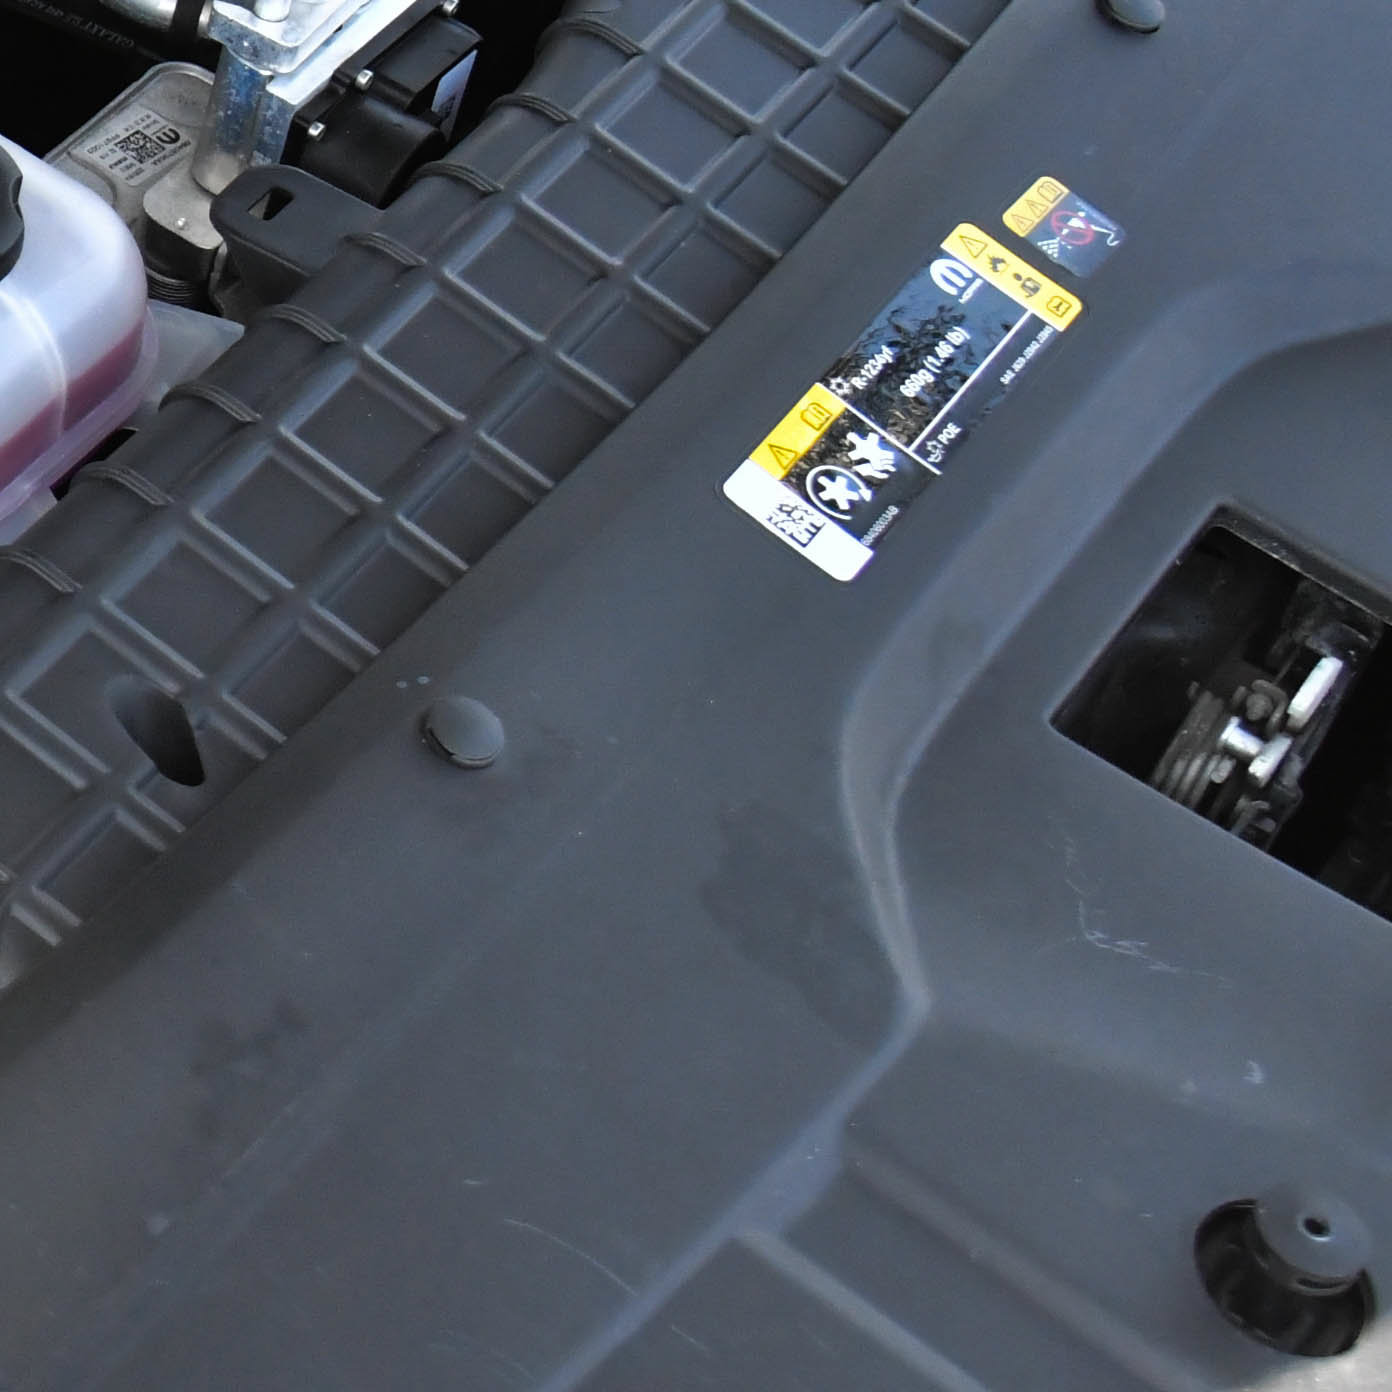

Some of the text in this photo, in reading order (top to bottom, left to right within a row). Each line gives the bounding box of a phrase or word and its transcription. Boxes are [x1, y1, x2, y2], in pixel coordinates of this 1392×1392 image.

[852, 344, 895, 390] R-1234yf
[899, 365, 935, 399] 660g
[925, 339, 954, 375] (1.46
[937, 421, 962, 445] POE
